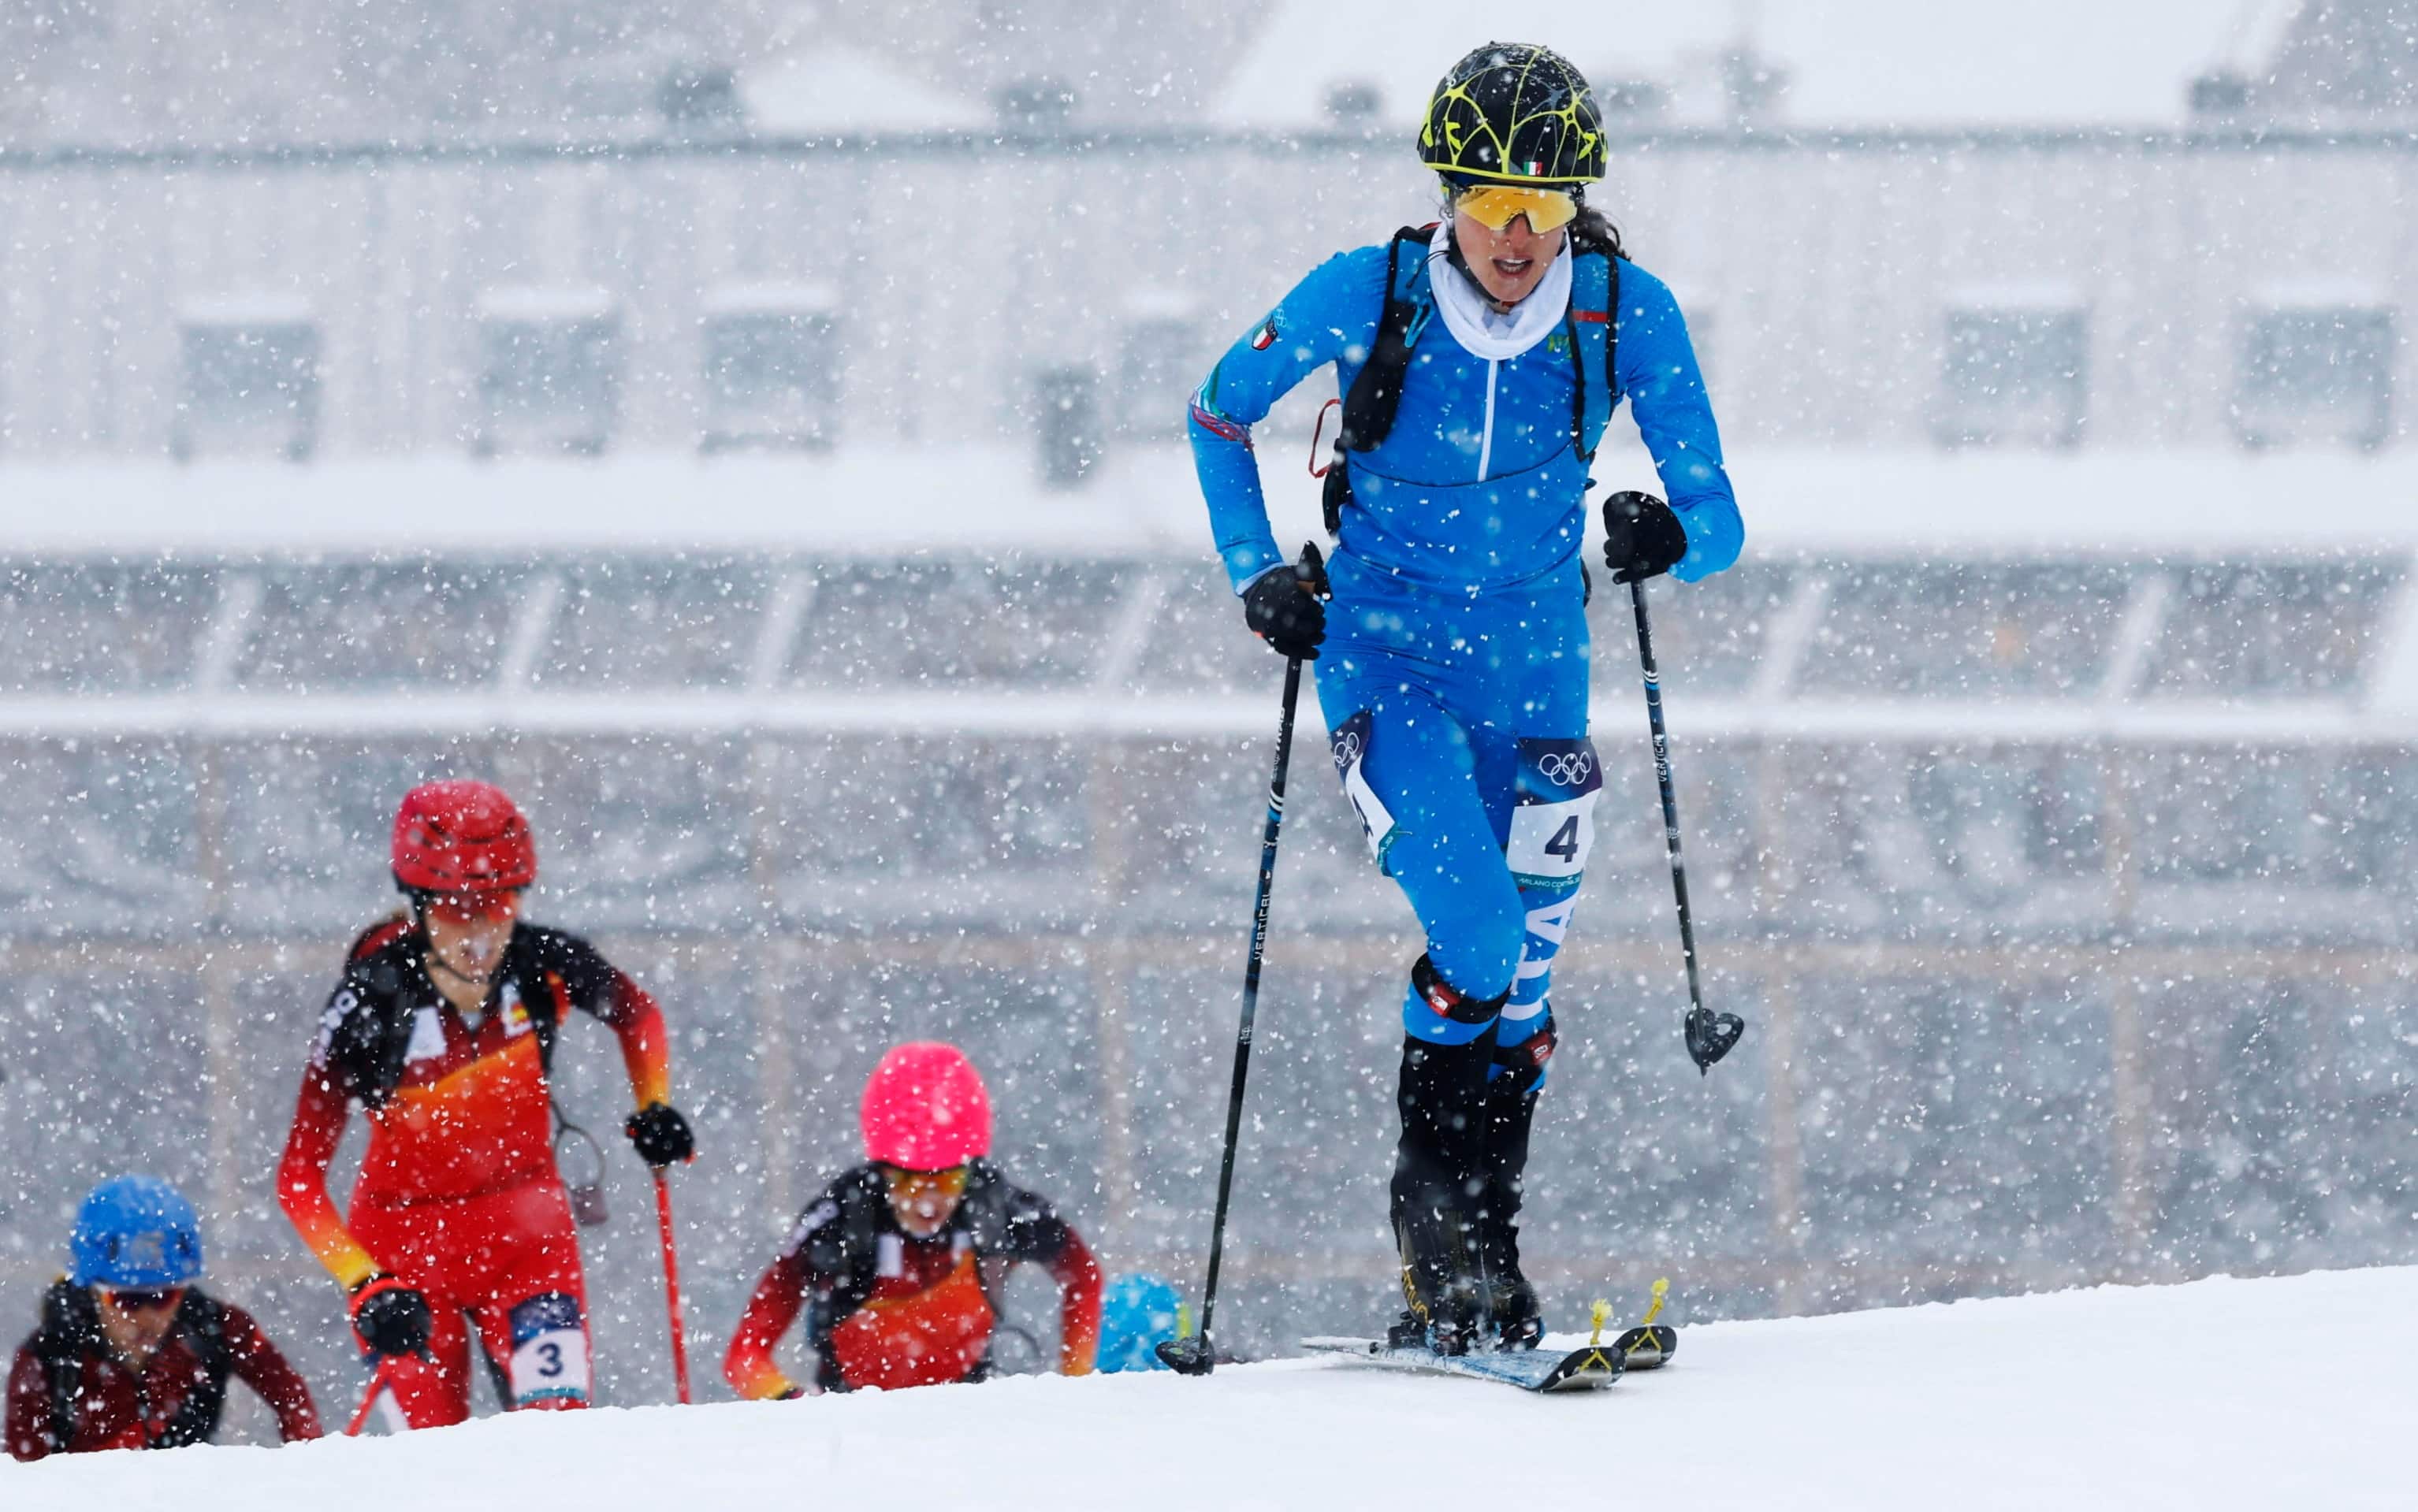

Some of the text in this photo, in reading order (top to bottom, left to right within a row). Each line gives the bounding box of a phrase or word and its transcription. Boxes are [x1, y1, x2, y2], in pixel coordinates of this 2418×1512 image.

[1654, 733, 1667, 782] VERTICA
[1544, 815, 1579, 864] 4
[538, 1342, 563, 1377] 3
